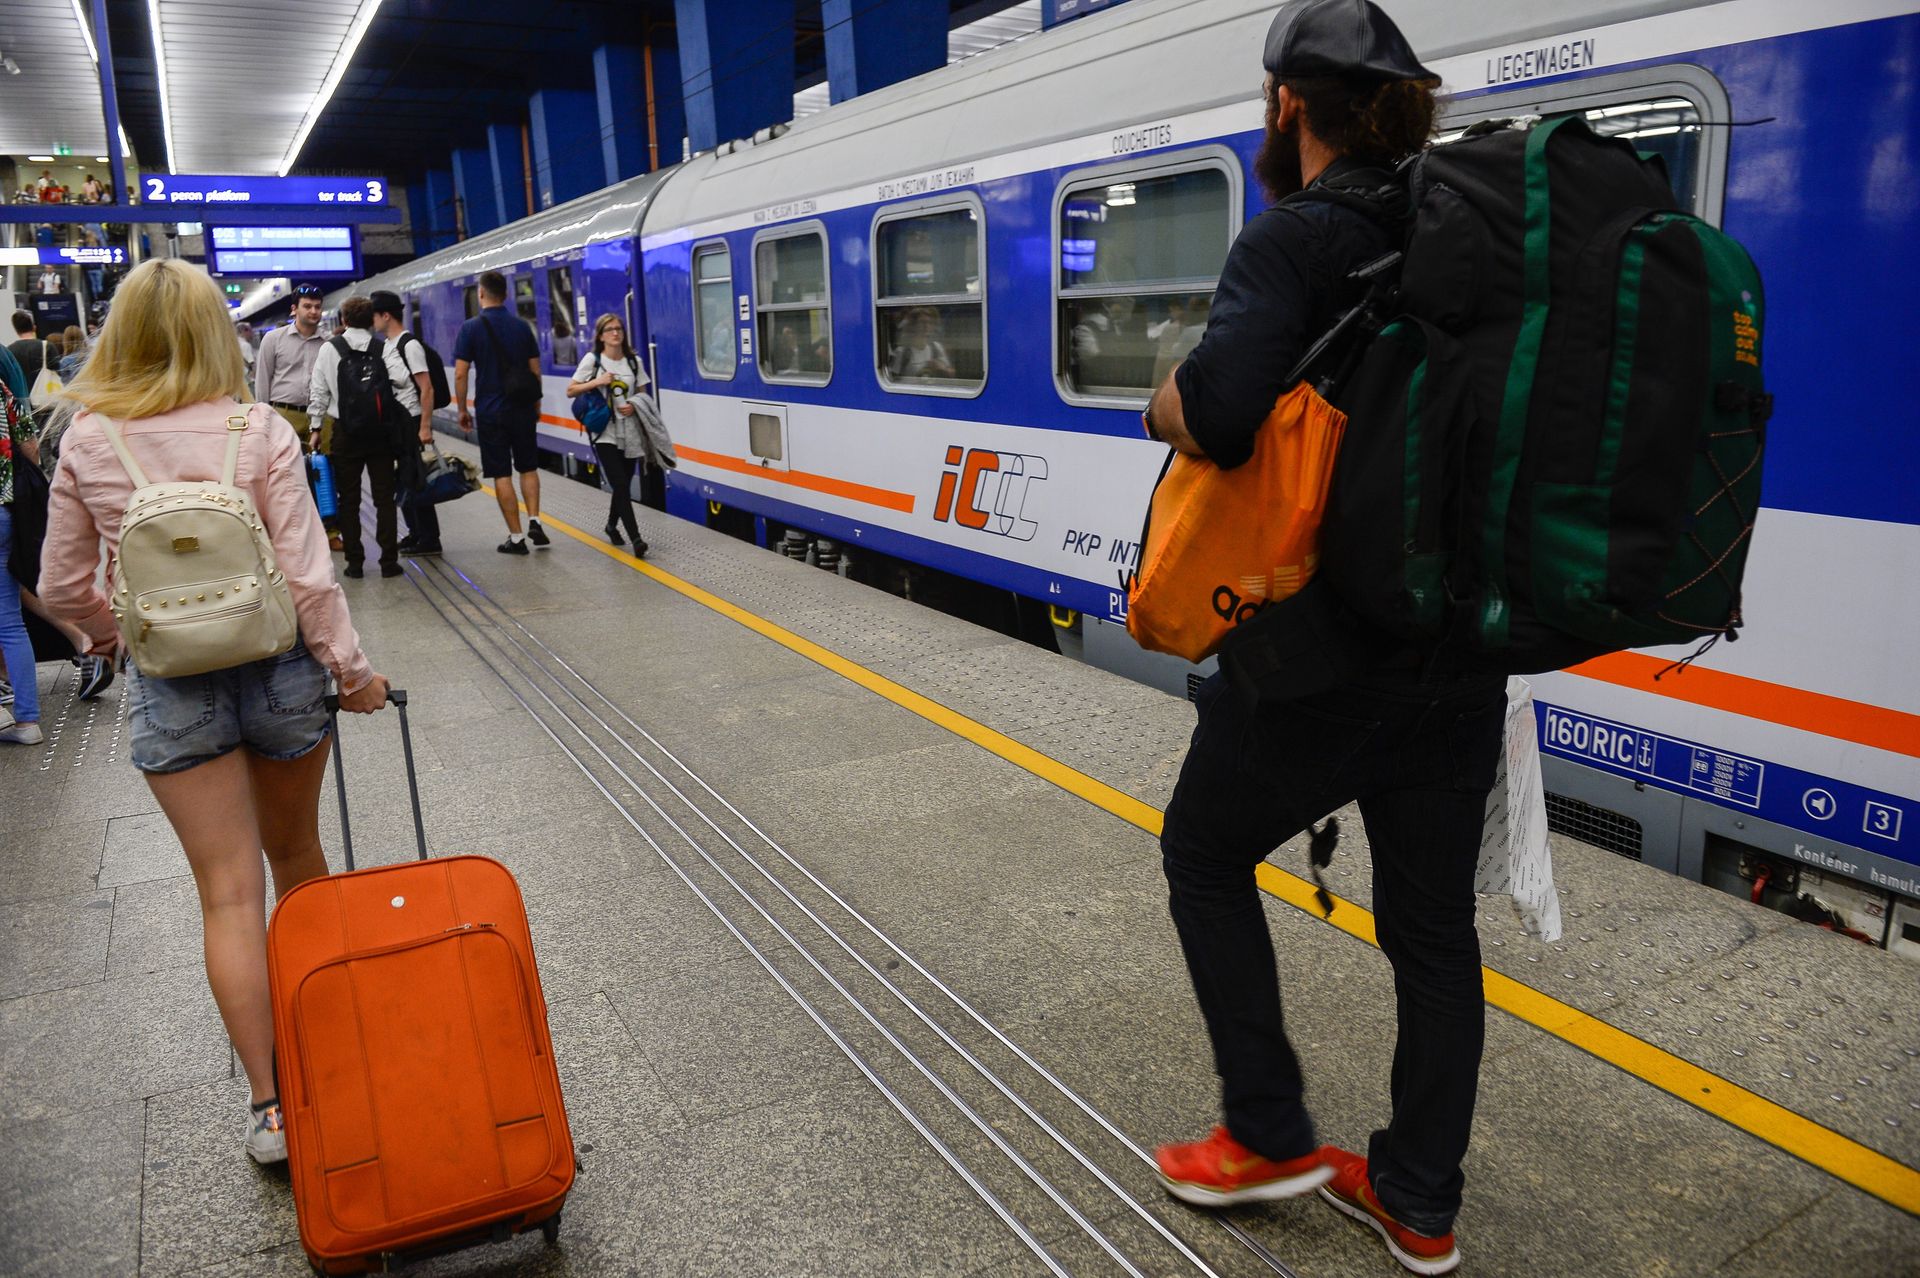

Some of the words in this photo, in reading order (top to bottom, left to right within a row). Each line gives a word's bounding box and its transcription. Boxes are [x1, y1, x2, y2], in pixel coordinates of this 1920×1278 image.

[1487, 38, 1595, 84] LIEGEWAGEN
[1113, 124, 1171, 153] COUCHETTES
[147, 178, 166, 200] 2
[170, 190, 203, 203] peron
[205, 189, 250, 202] platform
[318, 190, 335, 202] tor
[338, 191, 363, 202] track
[366, 181, 384, 203] 3
[1063, 529, 1101, 557] PKP
[1549, 714, 1589, 750] 160
[1592, 726, 1634, 763] RIC
[1874, 810, 1890, 831] 3
[1476, 855, 1494, 876] LEICA
[1794, 843, 1859, 875] Kontener
